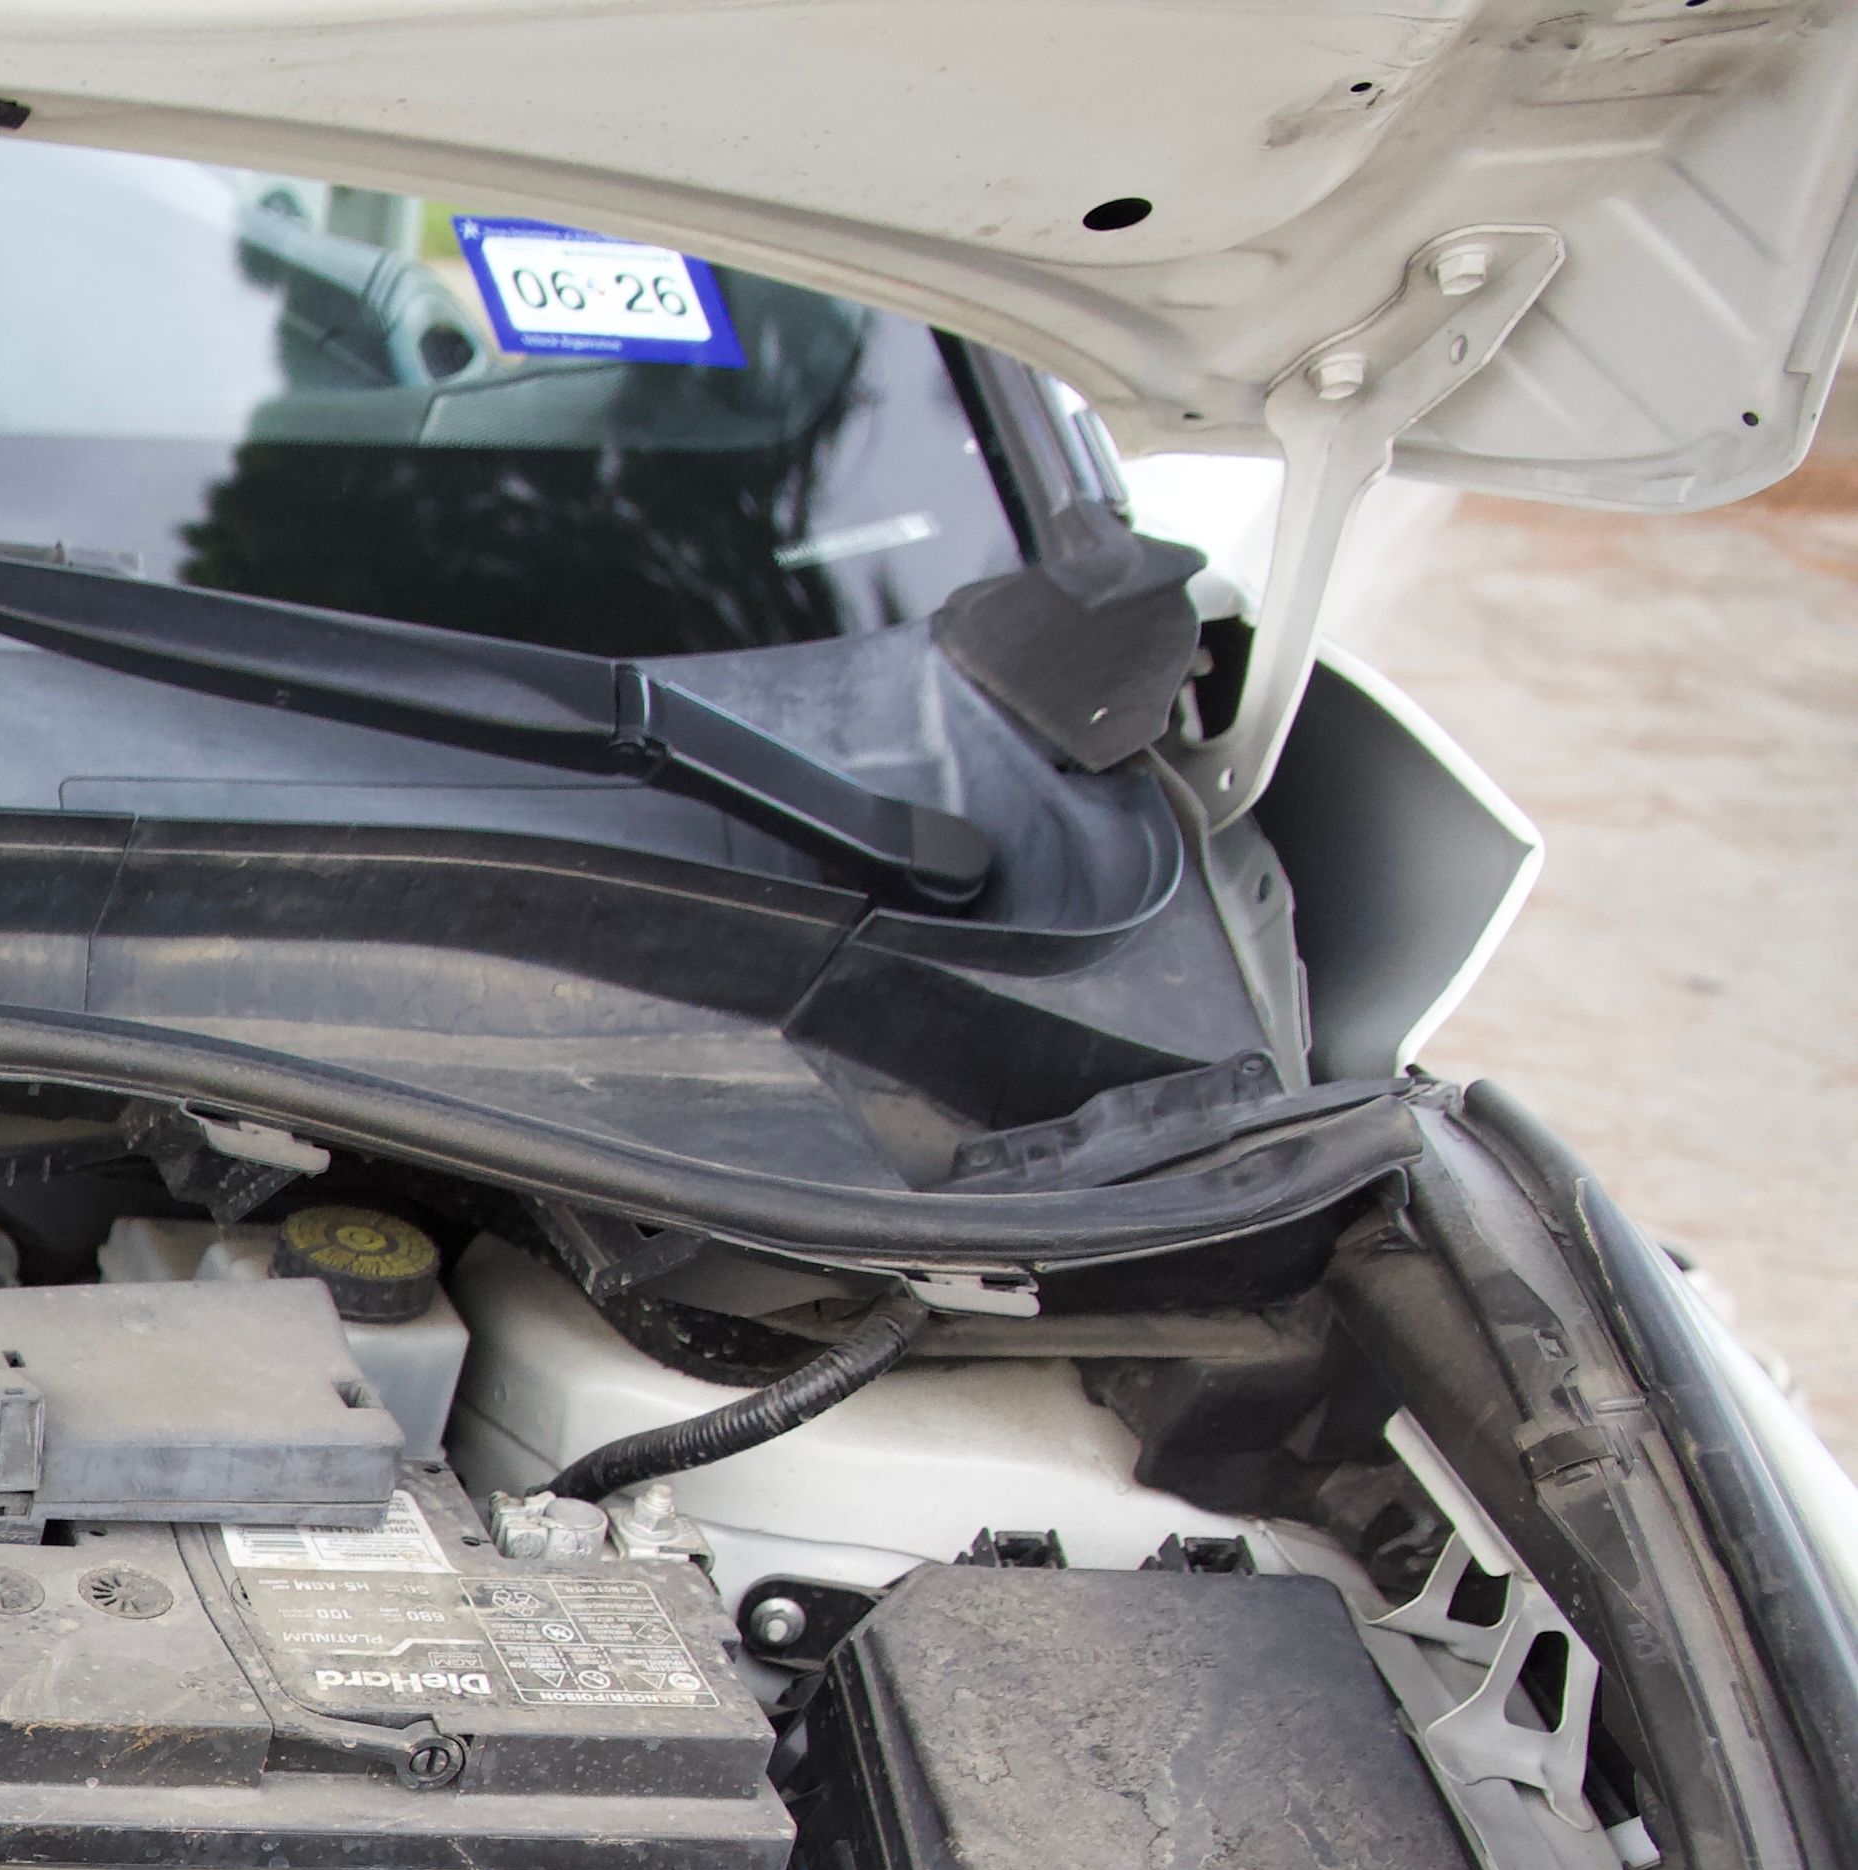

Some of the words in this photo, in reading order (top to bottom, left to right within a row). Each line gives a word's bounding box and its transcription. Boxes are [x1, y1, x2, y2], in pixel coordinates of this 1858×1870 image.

[513, 269, 586, 311] 06
[615, 273, 687, 316] 26
[316, 1608, 354, 1620] 100
[406, 1611, 446, 1623] 680
[283, 1631, 383, 1644] PLATINUM
[315, 1669, 492, 1695] DieHard
[539, 1692, 679, 1704] DANGER/POISON
